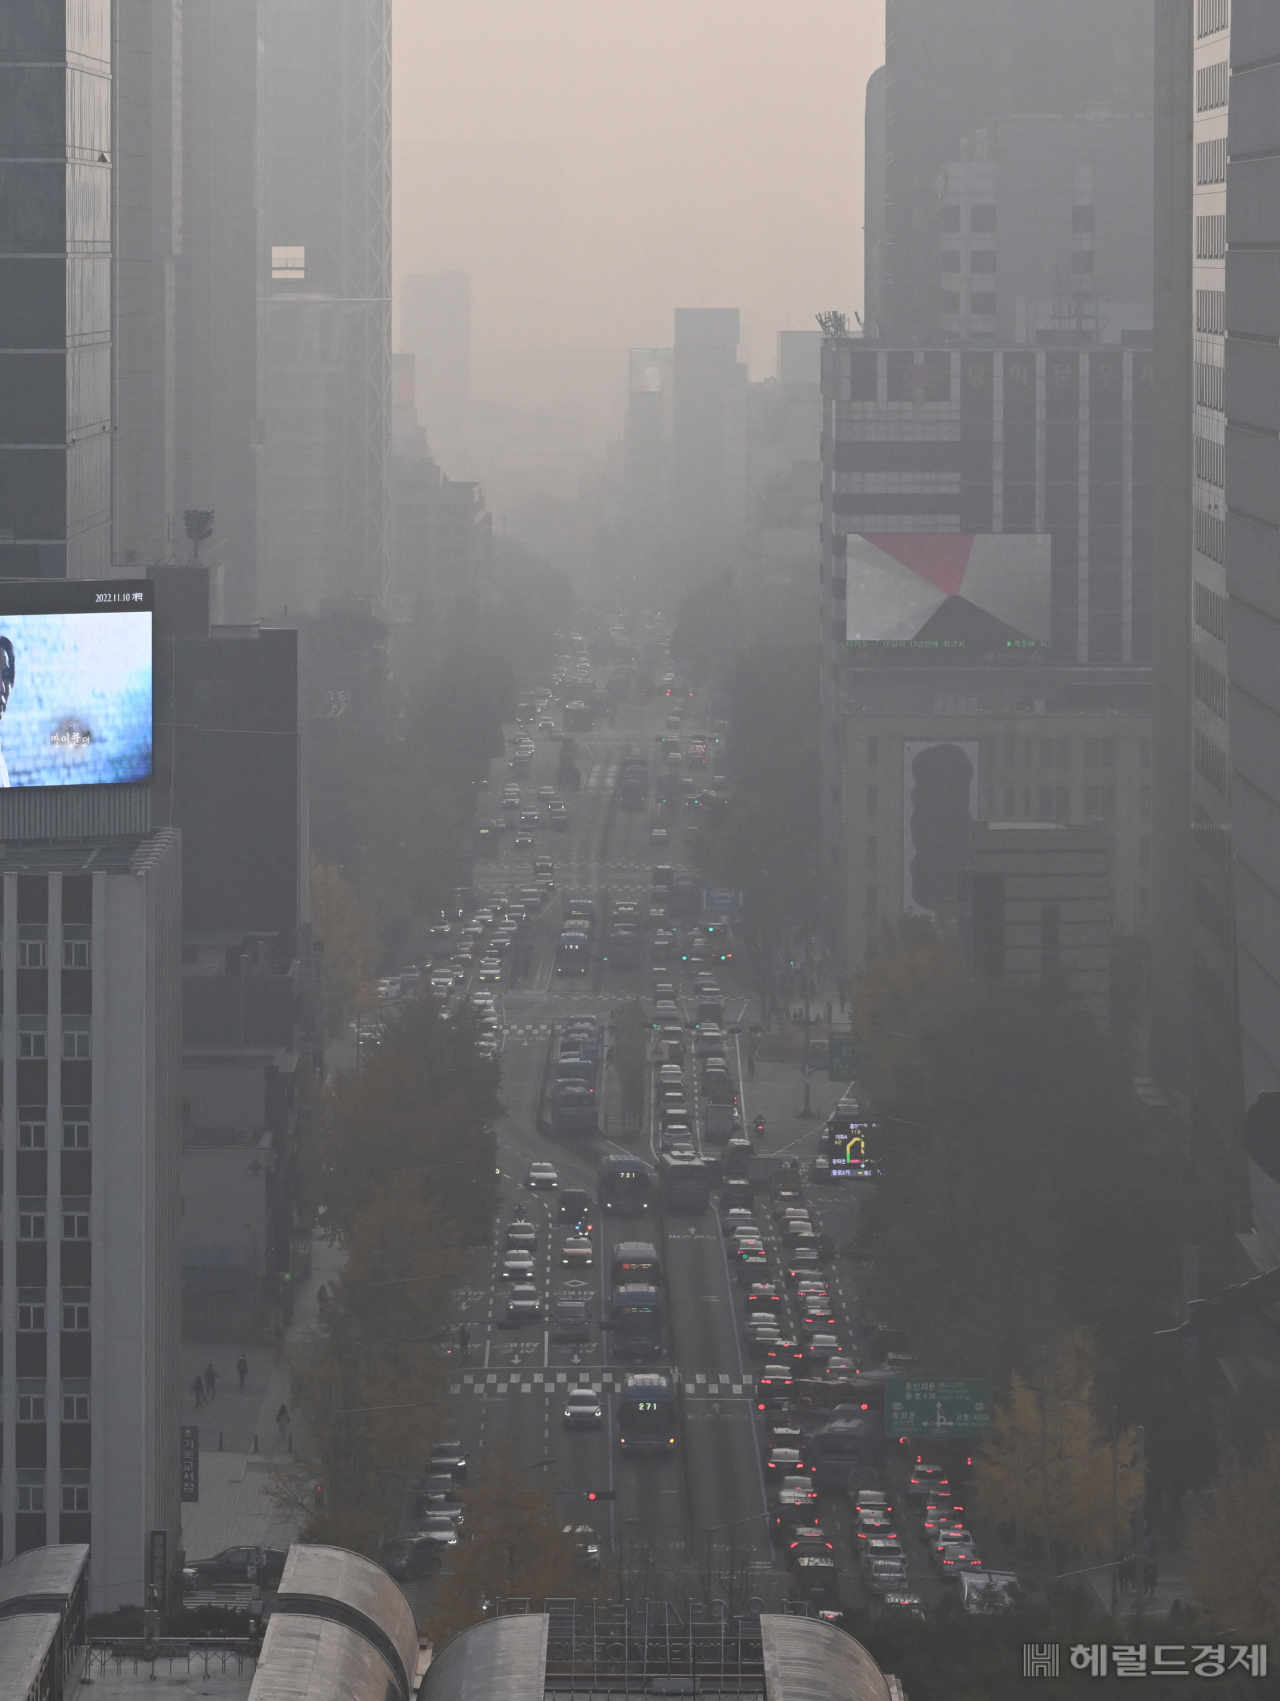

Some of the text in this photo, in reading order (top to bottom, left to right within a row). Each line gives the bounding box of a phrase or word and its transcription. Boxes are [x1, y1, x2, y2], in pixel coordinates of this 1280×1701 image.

[95, 593, 130, 602] 2022.11.10
[51, 732, 81, 746] 마이클
[638, 1402, 657, 1410] 271
[892, 1411, 917, 1420] 광화문
[182, 1438, 194, 1494] 기독교서점
